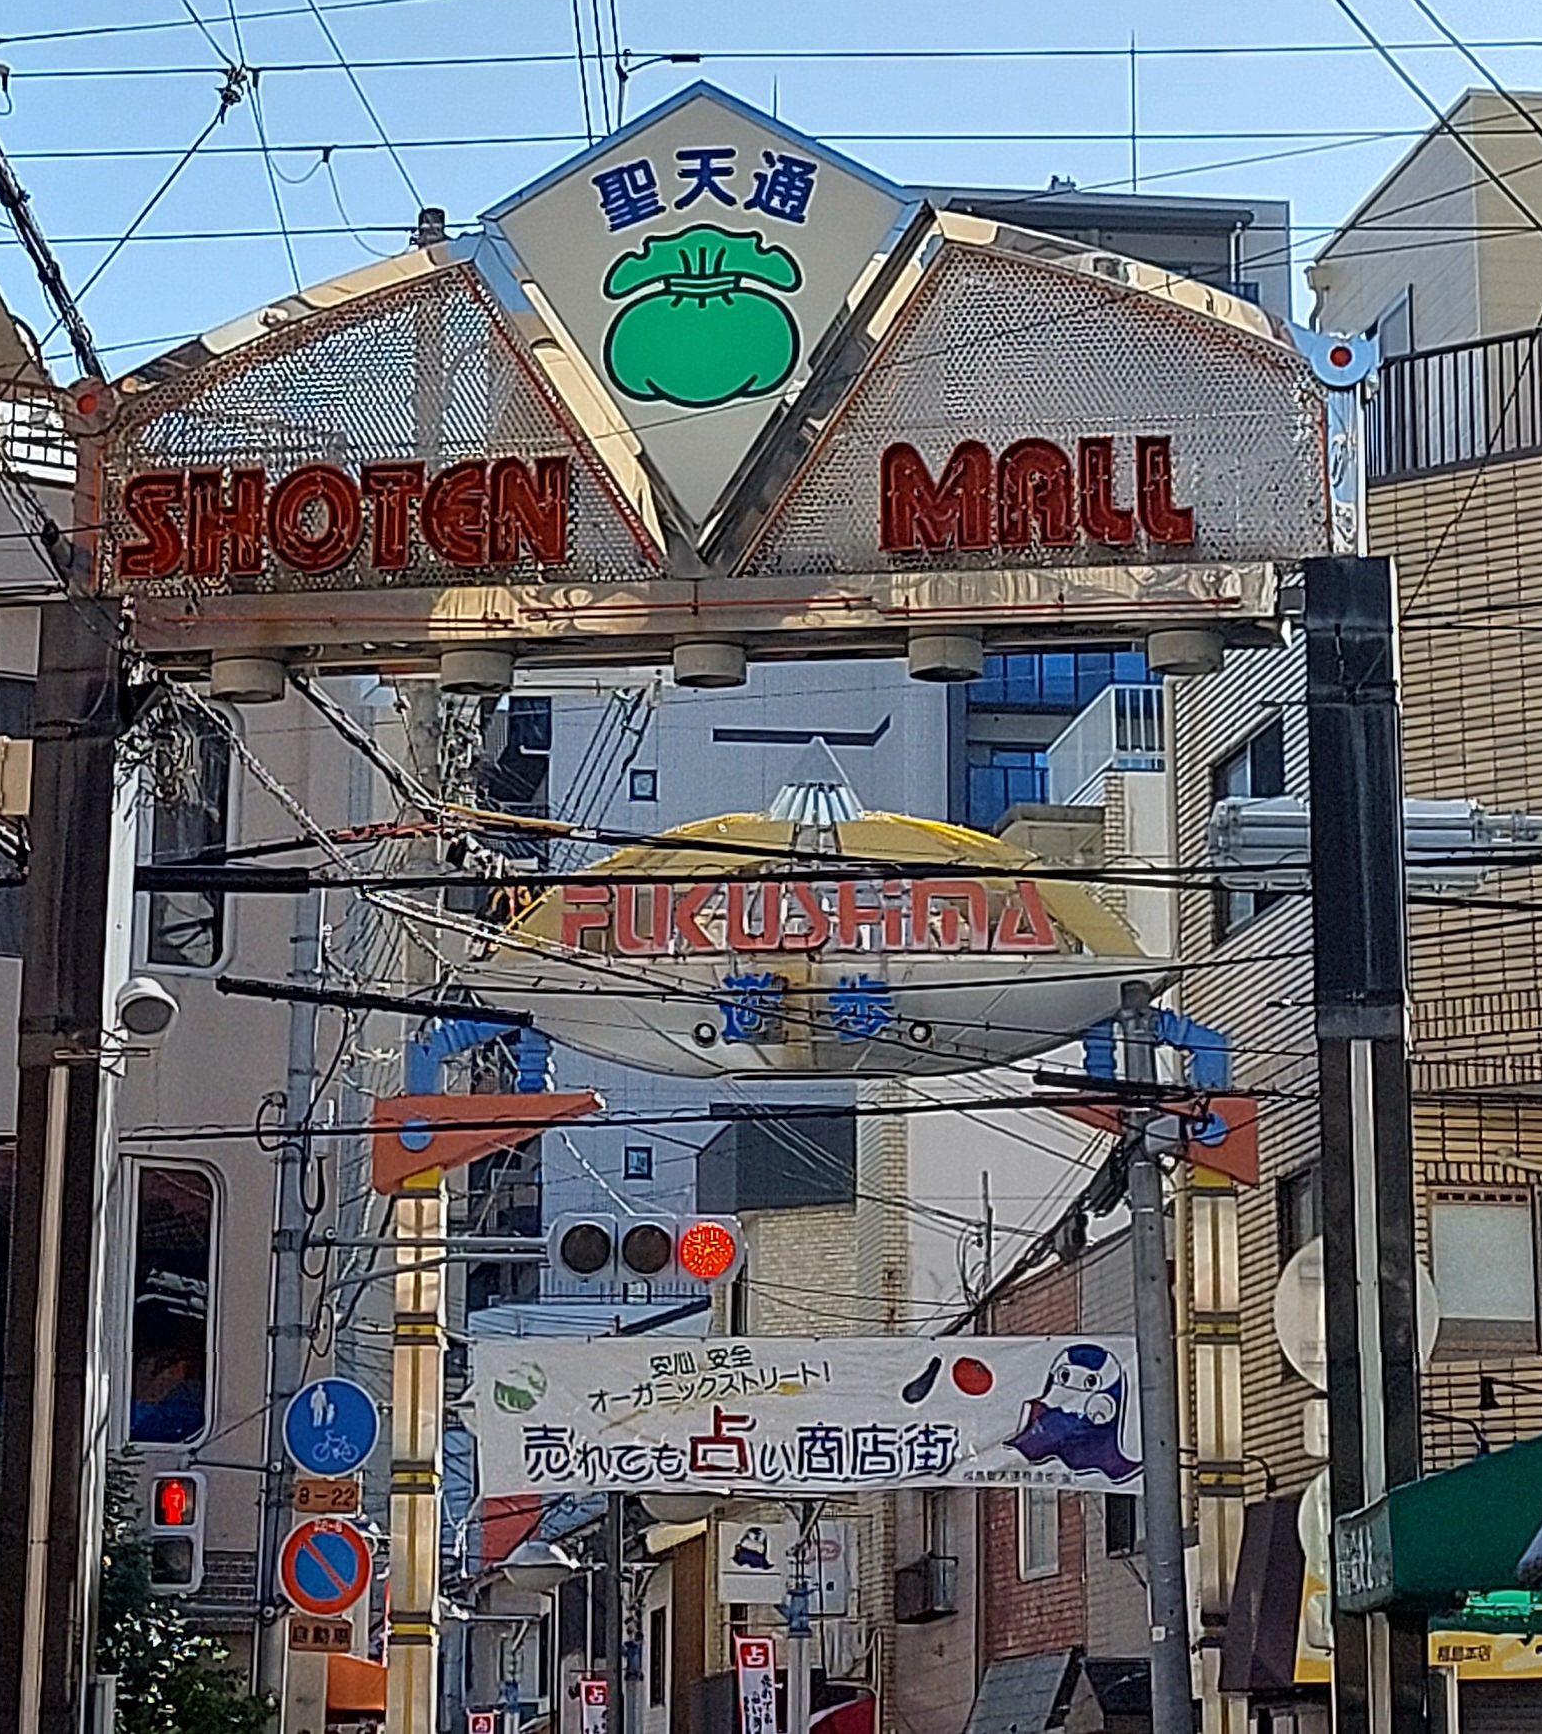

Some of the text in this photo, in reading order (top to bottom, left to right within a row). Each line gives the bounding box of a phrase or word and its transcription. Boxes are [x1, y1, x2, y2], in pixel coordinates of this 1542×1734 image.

[592, 146, 821, 232] 聖天通
[120, 434, 1197, 580] SHOTEN MALL
[522, 1405, 959, 1483] 売れても占い商店街
